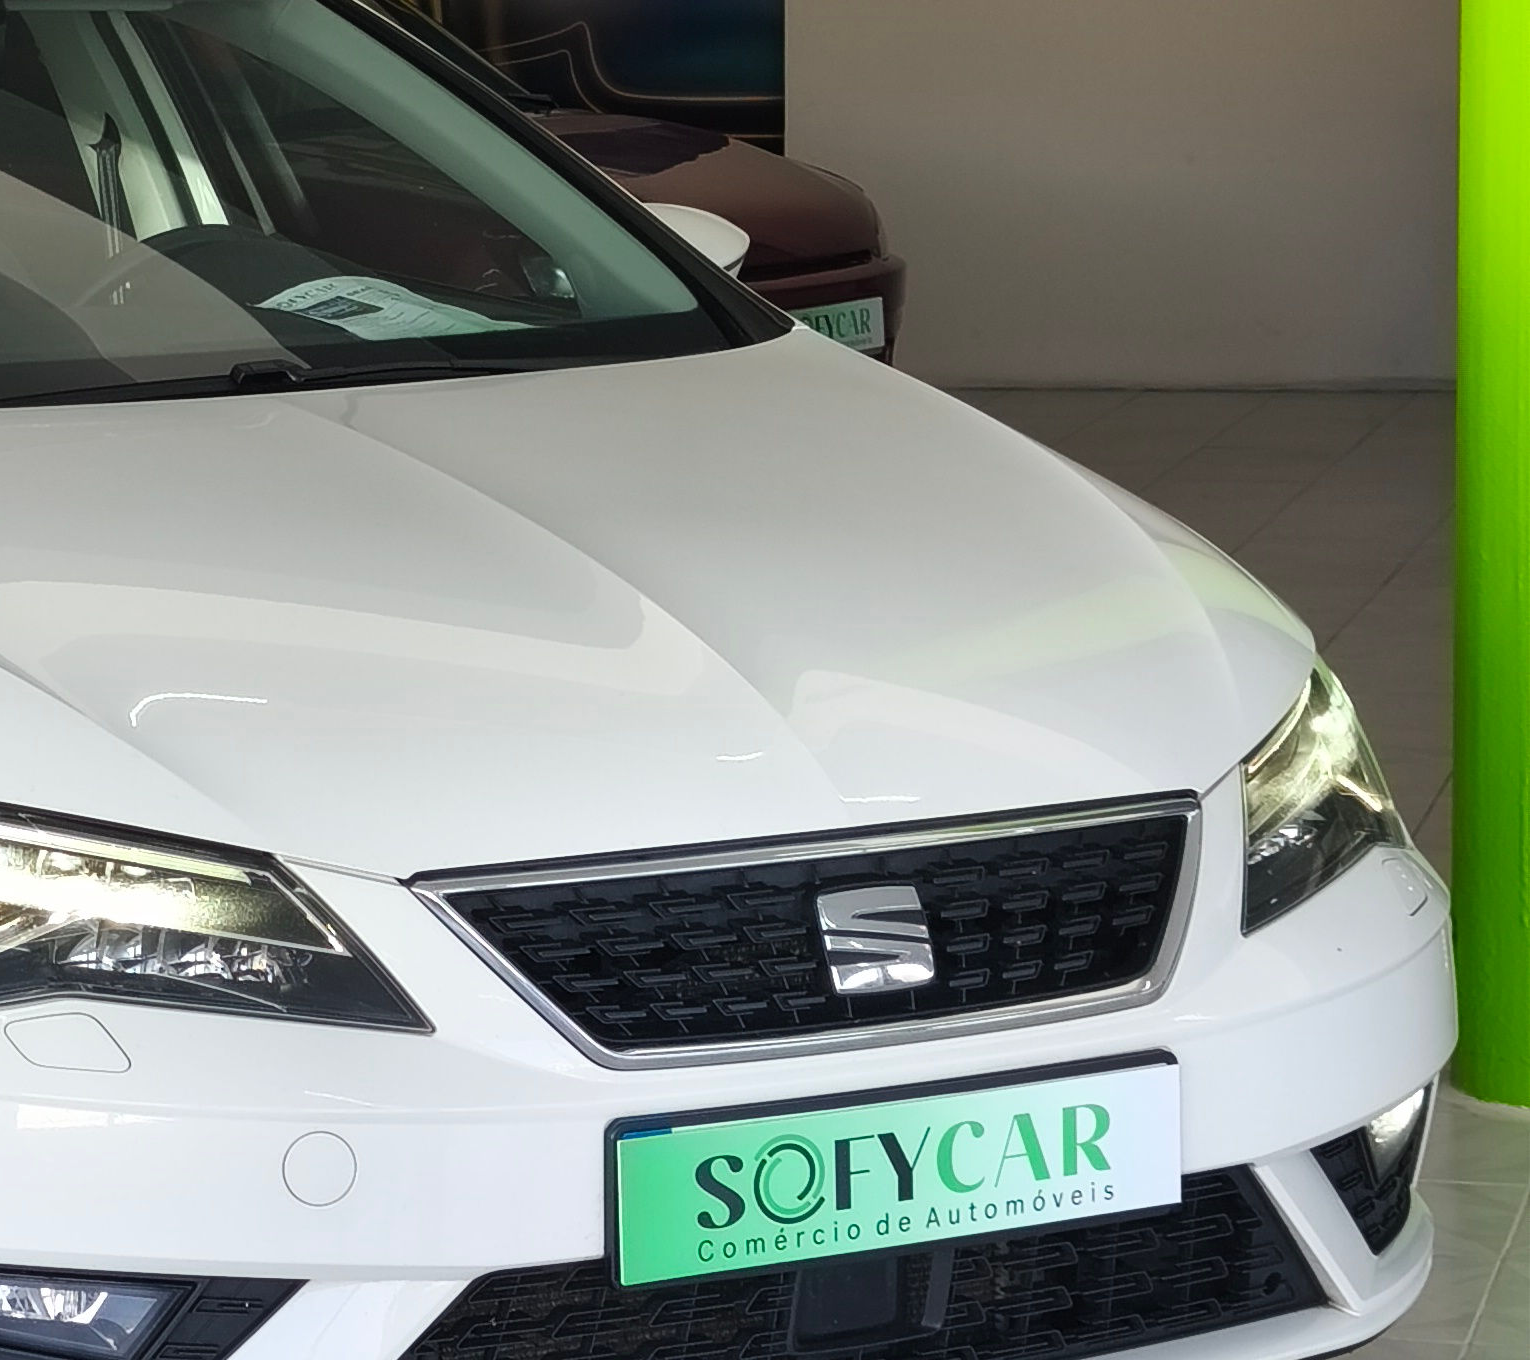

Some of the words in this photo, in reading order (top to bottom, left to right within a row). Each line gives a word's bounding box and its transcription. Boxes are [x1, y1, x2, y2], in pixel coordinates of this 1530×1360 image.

[694, 1102, 1112, 1230] SOFYCAR
[696, 1220, 861, 1264] Comércio
[875, 1212, 912, 1237] de
[925, 1181, 1116, 1230] Automóveis
